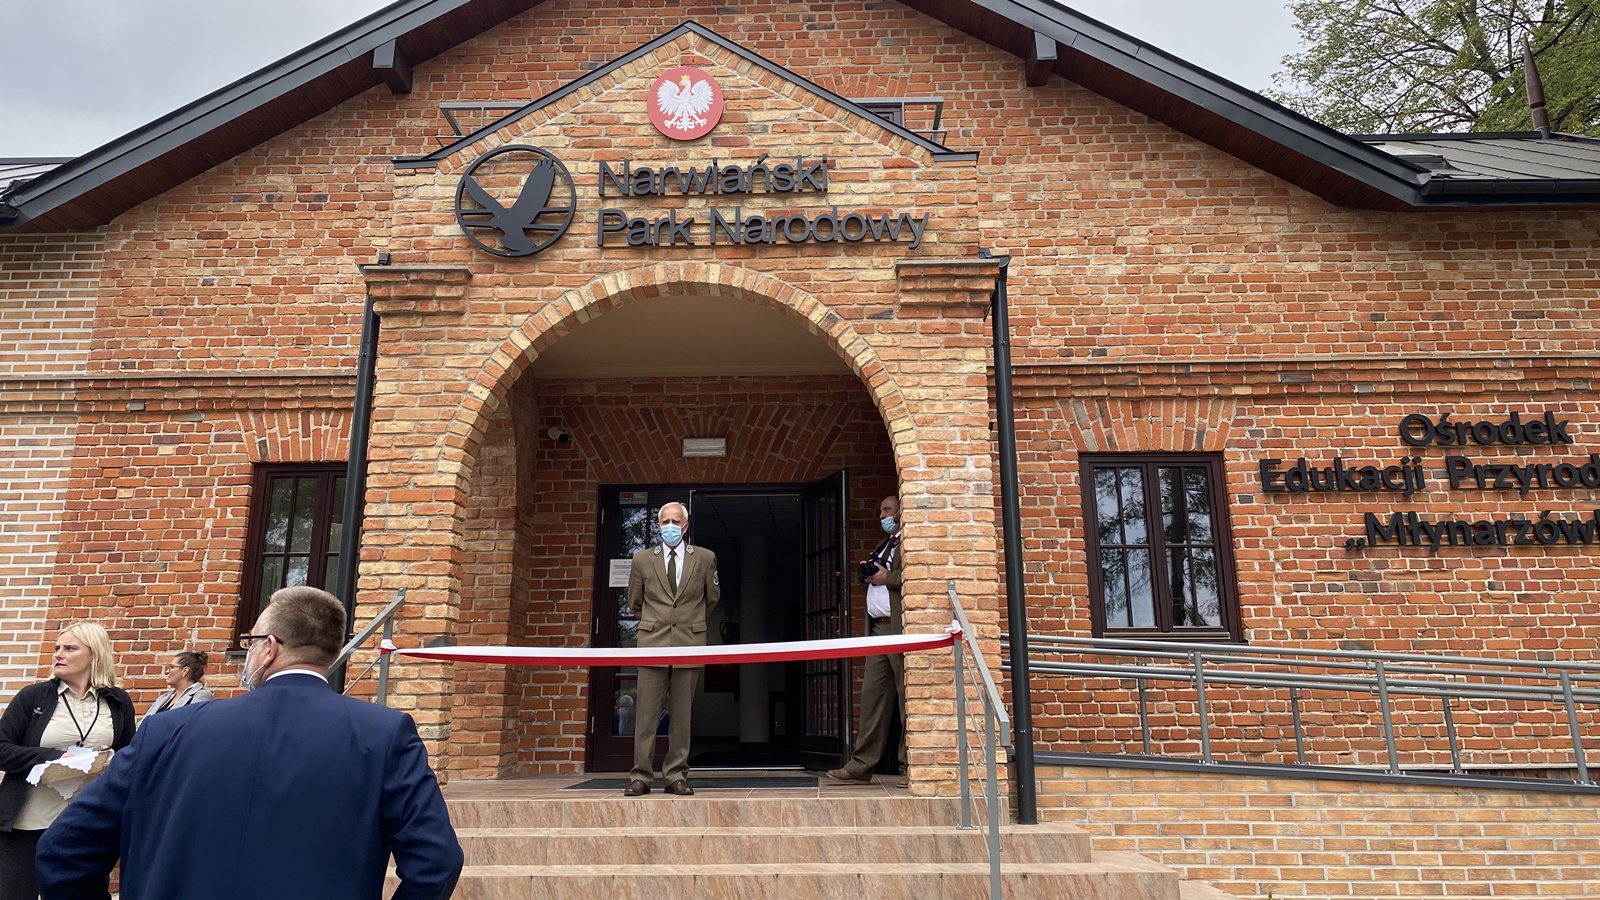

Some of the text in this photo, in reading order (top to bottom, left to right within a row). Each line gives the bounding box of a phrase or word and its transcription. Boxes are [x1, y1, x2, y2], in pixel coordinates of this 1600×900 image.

[598, 155, 829, 197] Narwiański
[597, 205, 930, 249] Park Narodowy
[1400, 410, 1574, 446] Ośrodek
[1259, 453, 1600, 496] Edukacji Przyrod
[1346, 509, 1600, 552] „Młynarzów
